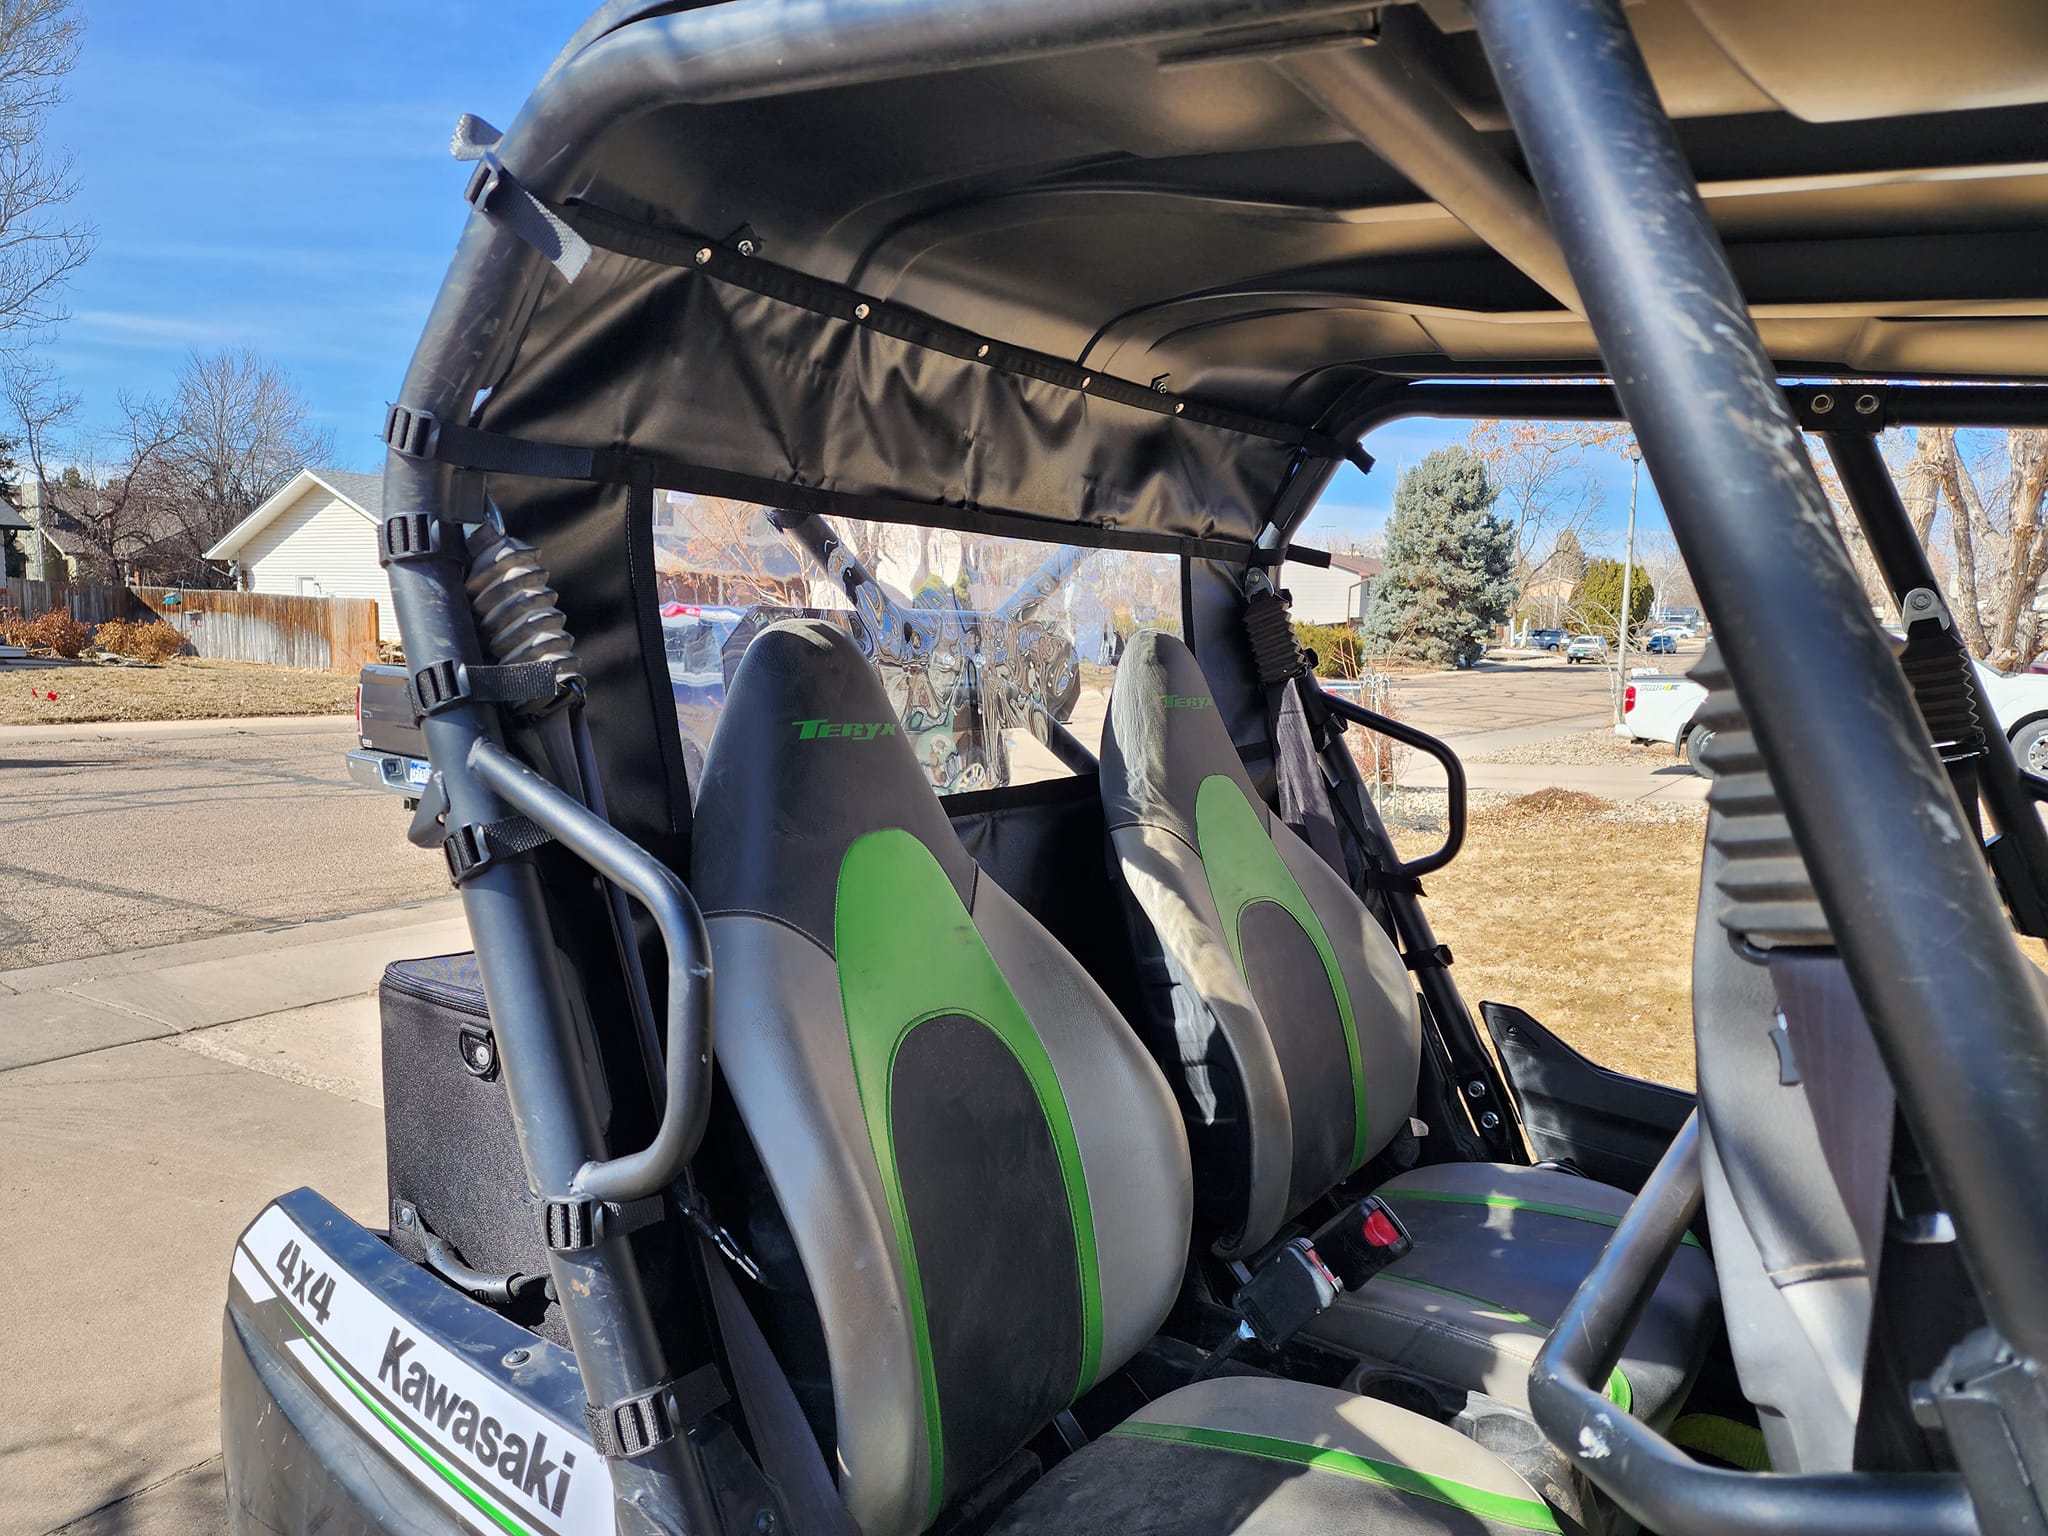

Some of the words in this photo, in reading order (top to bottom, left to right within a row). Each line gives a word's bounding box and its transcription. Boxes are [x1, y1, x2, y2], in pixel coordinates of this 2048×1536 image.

[792, 720, 896, 740] TERYX
[276, 1239, 337, 1326] 4x4
[378, 1326, 577, 1519] Kawasaki
